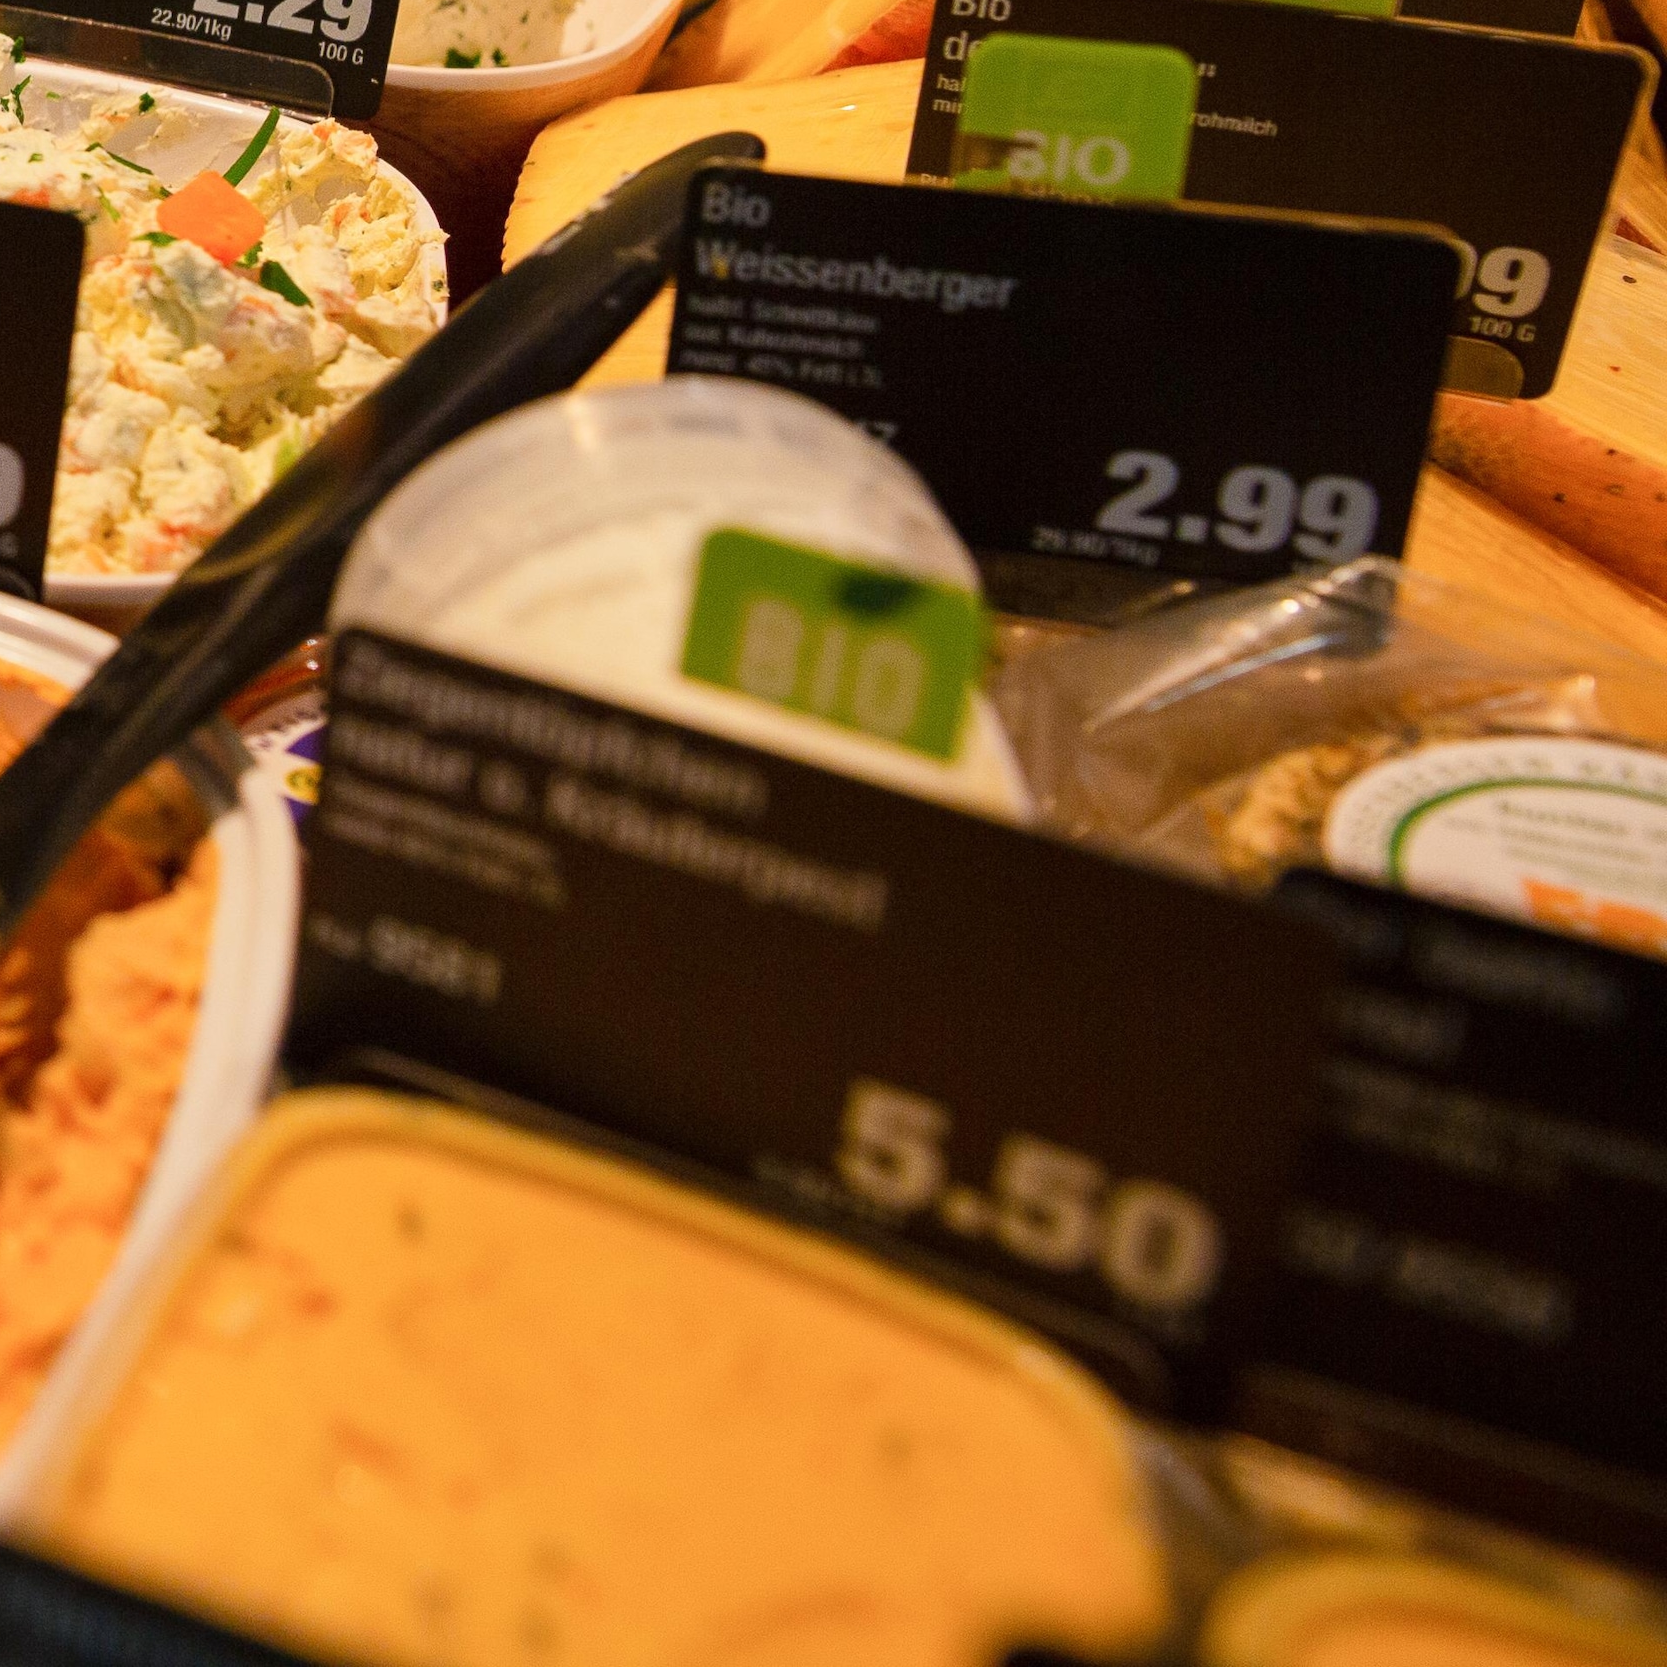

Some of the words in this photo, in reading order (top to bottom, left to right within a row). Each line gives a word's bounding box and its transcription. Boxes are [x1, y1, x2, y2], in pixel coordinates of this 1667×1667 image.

[151, 8, 233, 42] 22.90/1kg
[317, 41, 349, 63] 100
[352, 47, 365, 66] G
[700, 180, 771, 230] Bio
[691, 237, 1020, 313] Weissenberger
[1469, 316, 1513, 338] 100
[1516, 323, 1536, 342] G
[1094, 448, 1382, 564] 2.99
[833, 1073, 1224, 1311] 5.50
